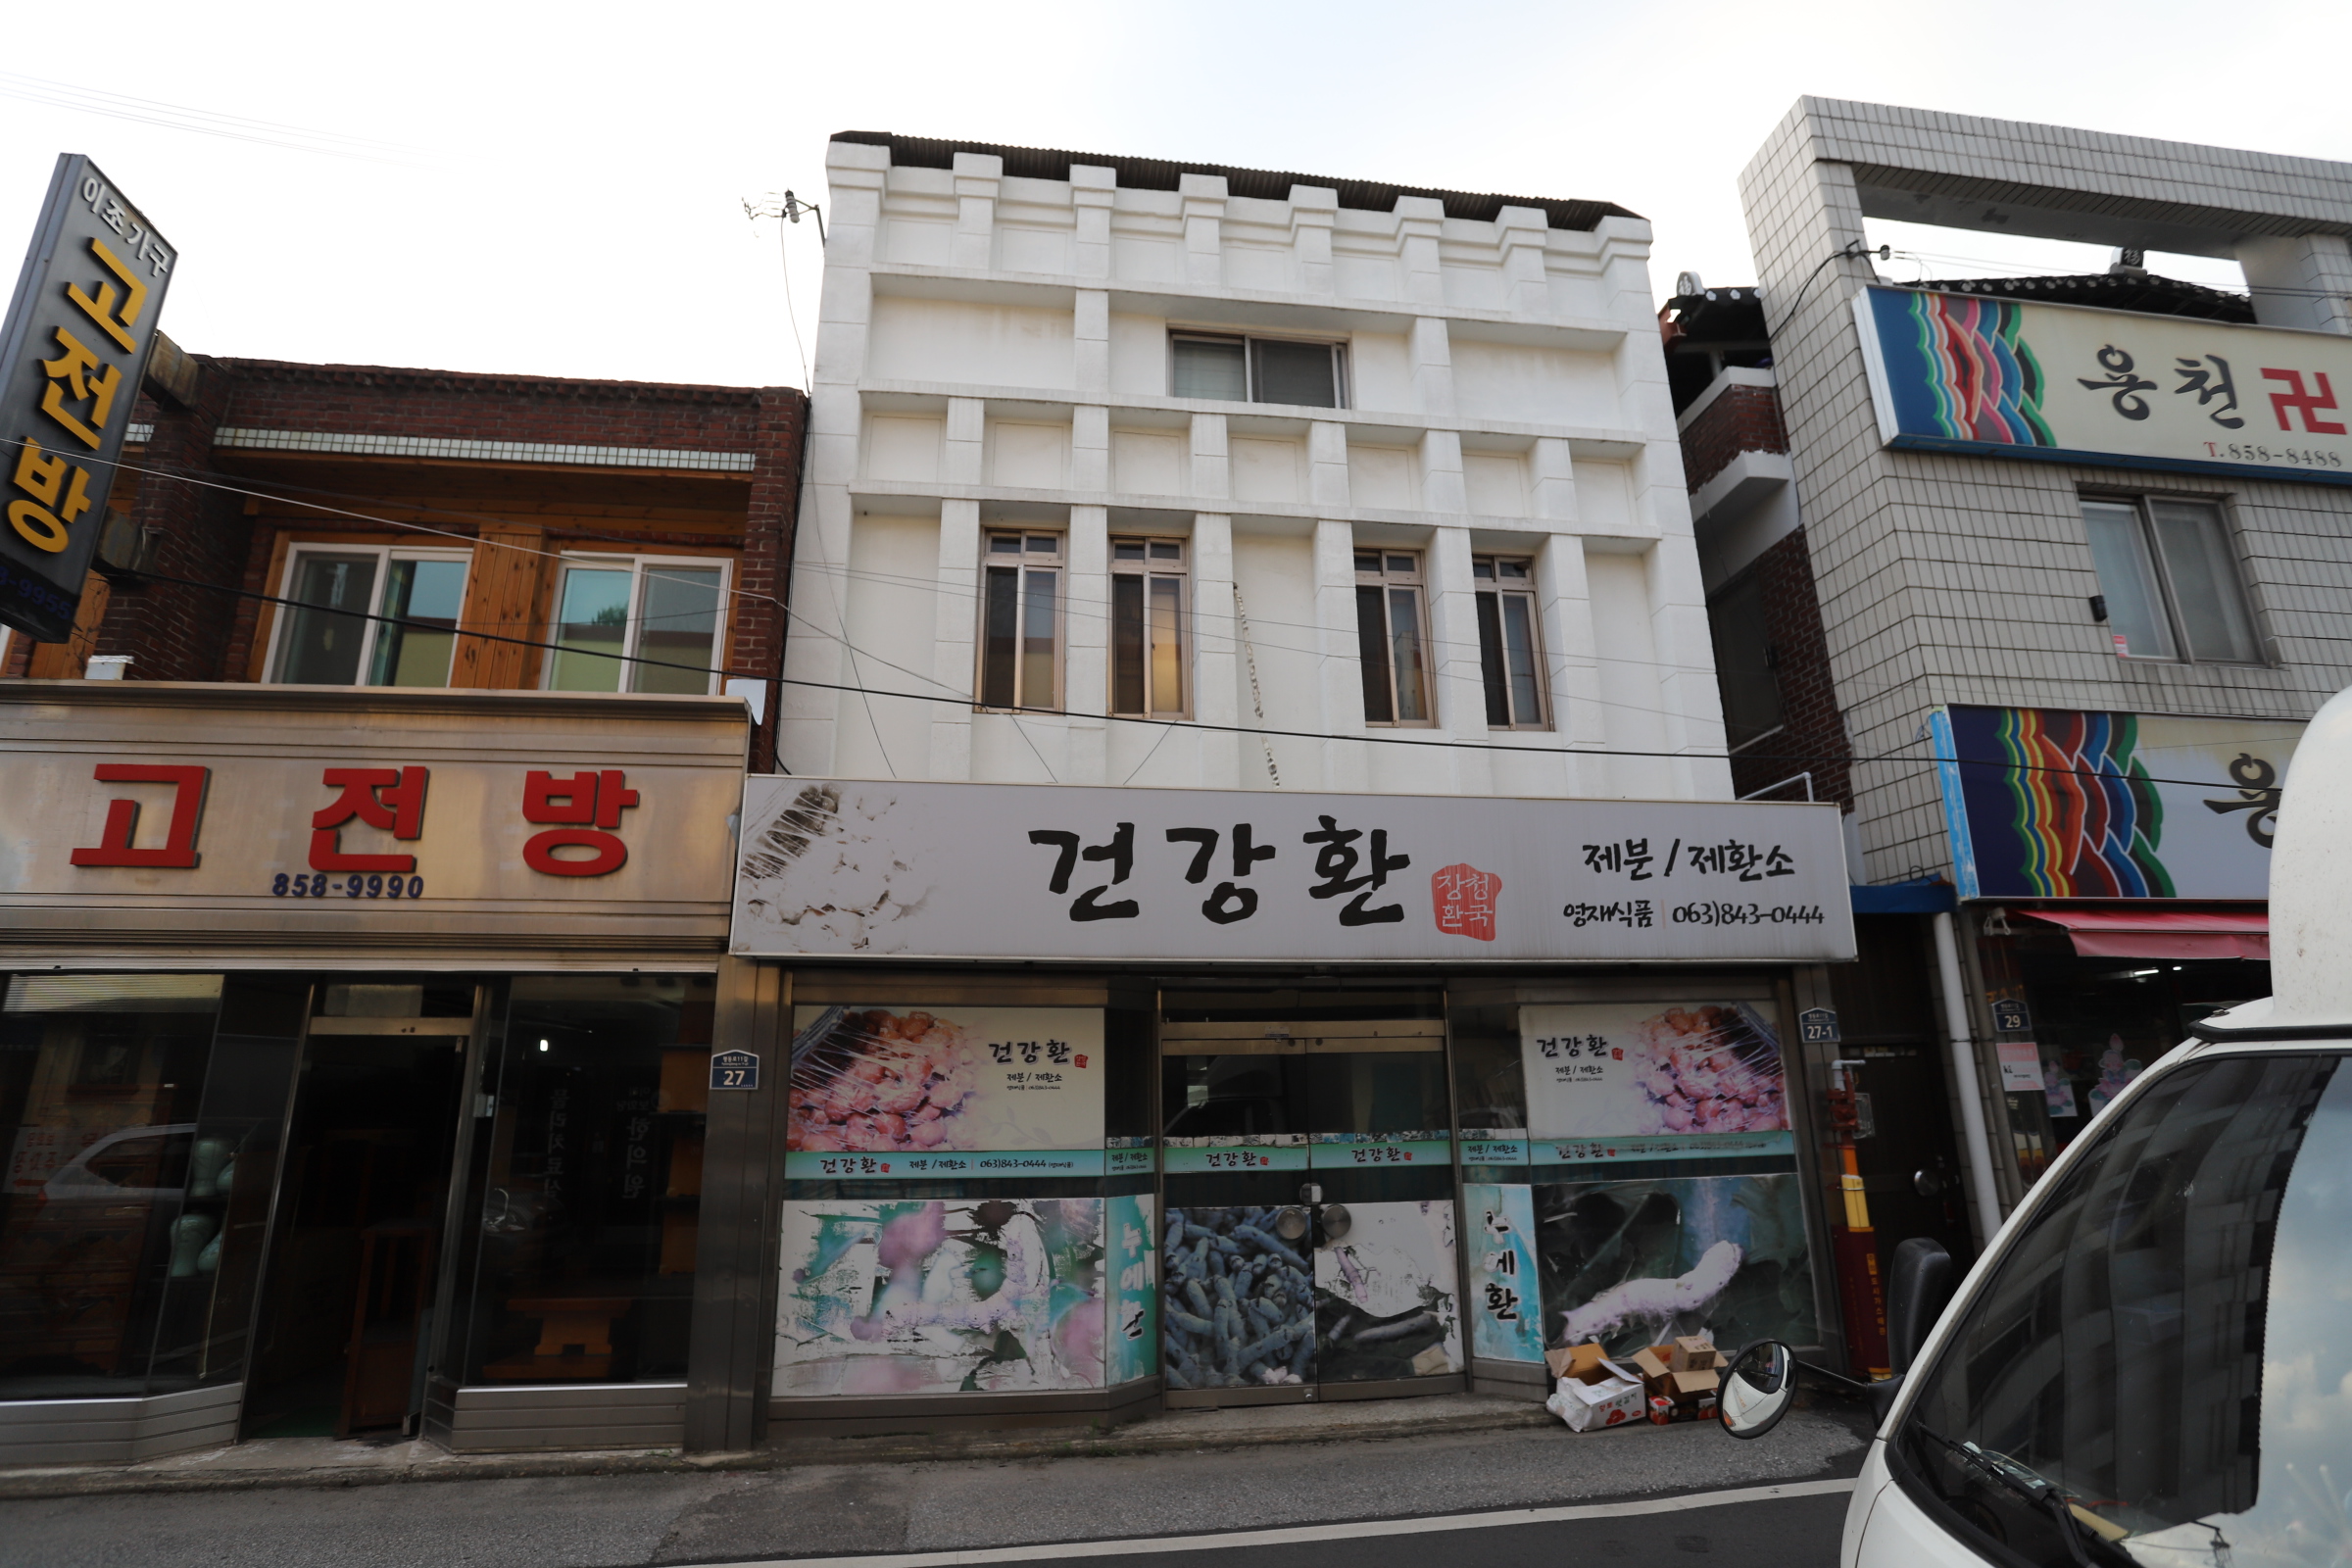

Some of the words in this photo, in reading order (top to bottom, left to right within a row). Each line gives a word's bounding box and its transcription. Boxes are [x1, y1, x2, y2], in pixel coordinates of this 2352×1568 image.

[82, 175, 171, 278] 이조가구
[7, 236, 148, 554] 고전방
[70, 763, 639, 877] 고전방
[1028, 814, 1411, 927] 건강환
[271, 873, 424, 900] 858-9990
[1563, 900, 1654, 928] 영재식품
[1672, 900, 1825, 927] 063)843-0444
[1807, 1025, 1834, 1040] 27-1
[2004, 1014, 2022, 1028] 29
[989, 1039, 1071, 1065] 건강환
[1536, 1034, 1609, 1059] 건강환
[723, 1070, 746, 1086] 27
[819, 1157, 877, 1174] 건강환
[1205, 1150, 1256, 1167] 건강환
[1351, 1146, 1400, 1163] 건강환
